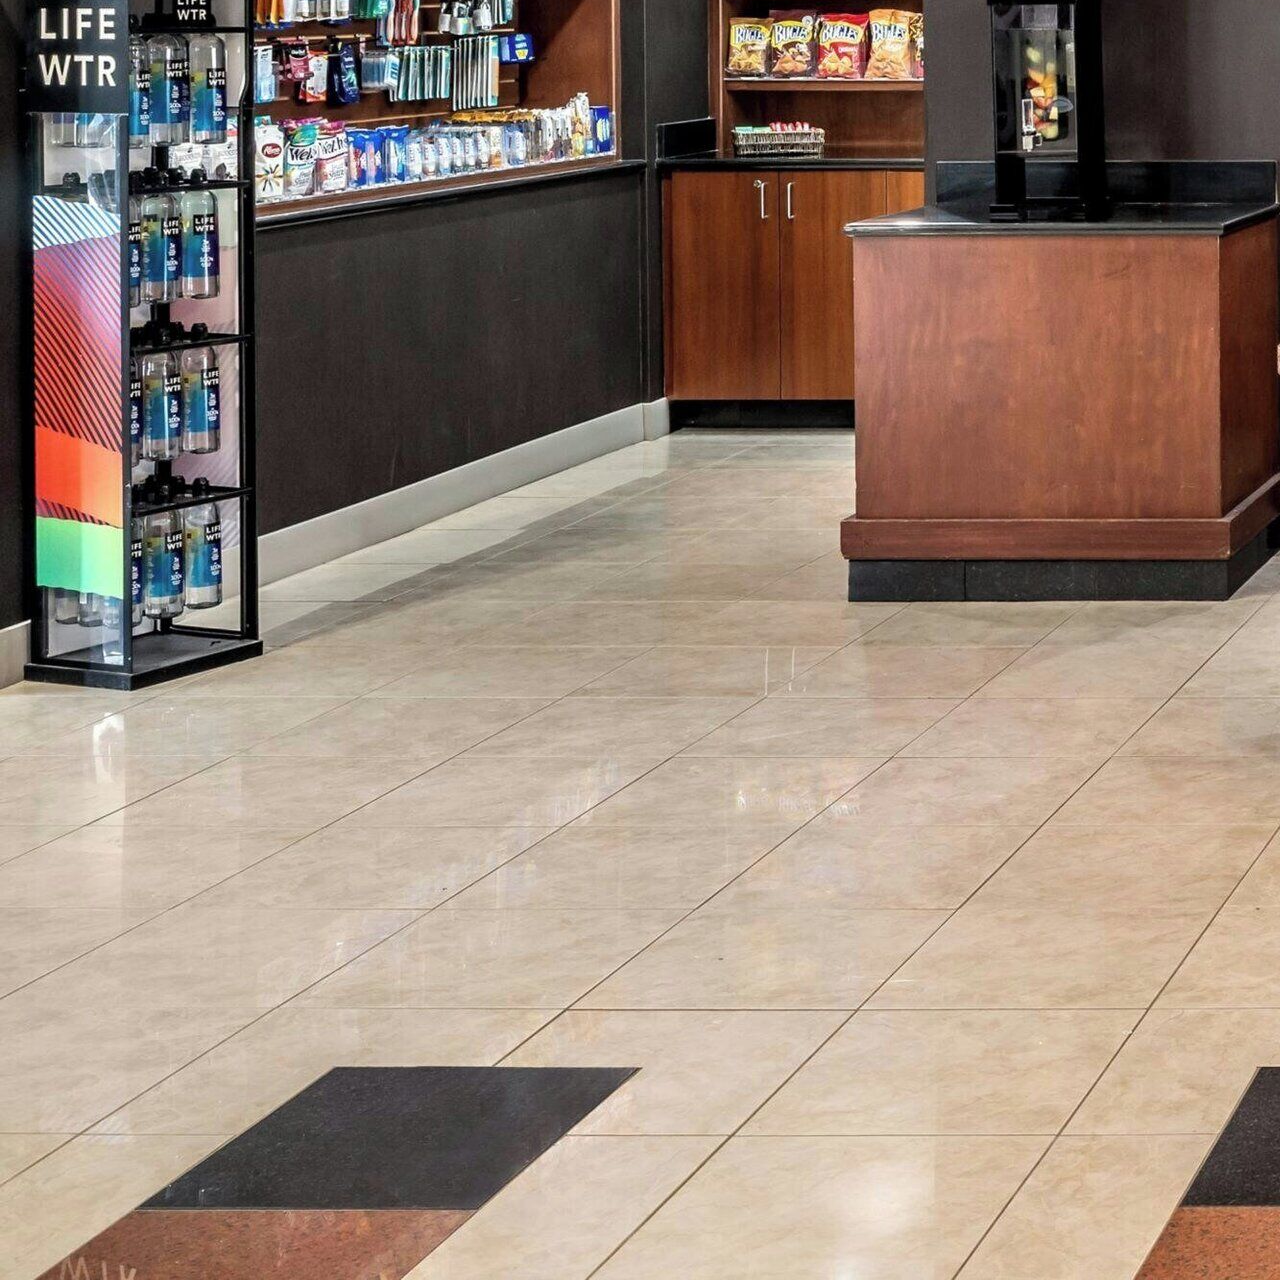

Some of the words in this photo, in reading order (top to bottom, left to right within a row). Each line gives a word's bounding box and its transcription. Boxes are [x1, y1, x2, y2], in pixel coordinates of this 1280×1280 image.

[39, 8, 116, 40] LIFE
[176, 8, 207, 20] WTR
[38, 54, 117, 87] WTR
